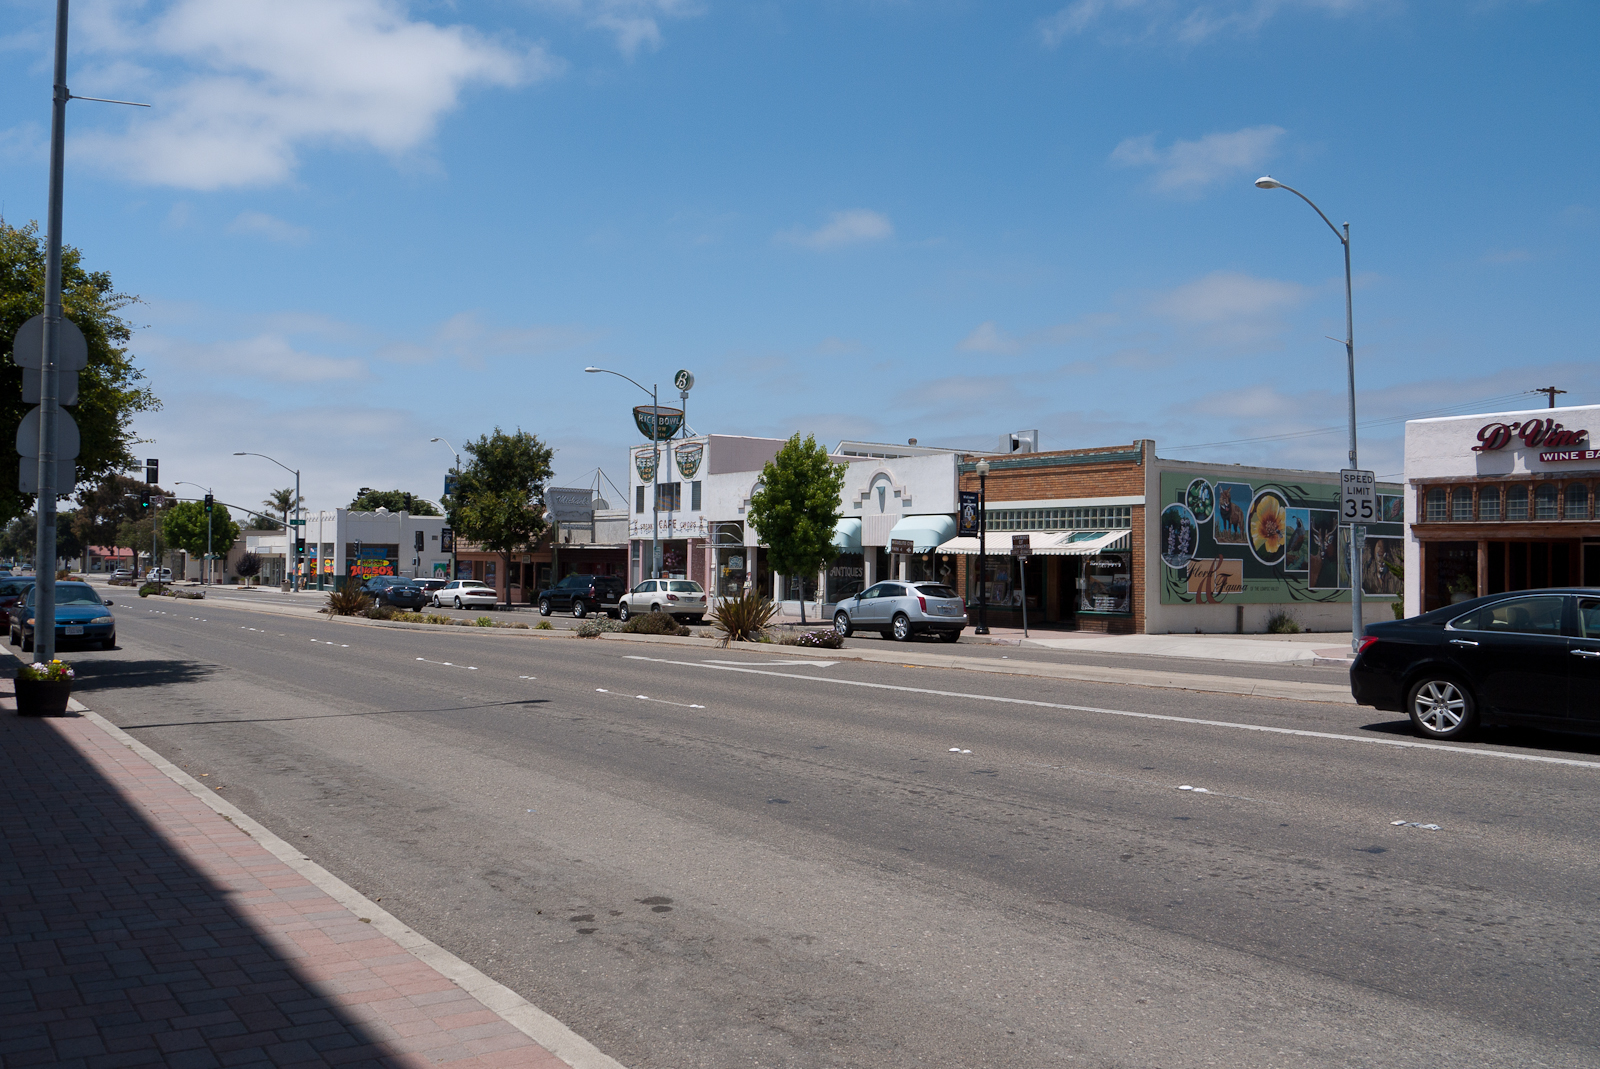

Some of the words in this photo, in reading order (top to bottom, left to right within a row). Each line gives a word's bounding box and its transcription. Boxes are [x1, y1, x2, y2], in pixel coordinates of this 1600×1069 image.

[638, 414, 655, 424] RICE
[658, 416, 680, 426] BOWL
[1471, 418, 1589, 452] D'Vine
[1542, 452, 1579, 461] WINE
[1344, 474, 1373, 484] SPEED
[1347, 486, 1370, 496] LIMIT
[1344, 499, 1374, 518] 35
[658, 519, 677, 529] CAFE
[350, 566, 364, 576] 20
[372, 566, 394, 576] 50%
[830, 566, 864, 578] ANTIQUES
[1183, 558, 1214, 583] Flora
[1214, 573, 1248, 598] Fauna
